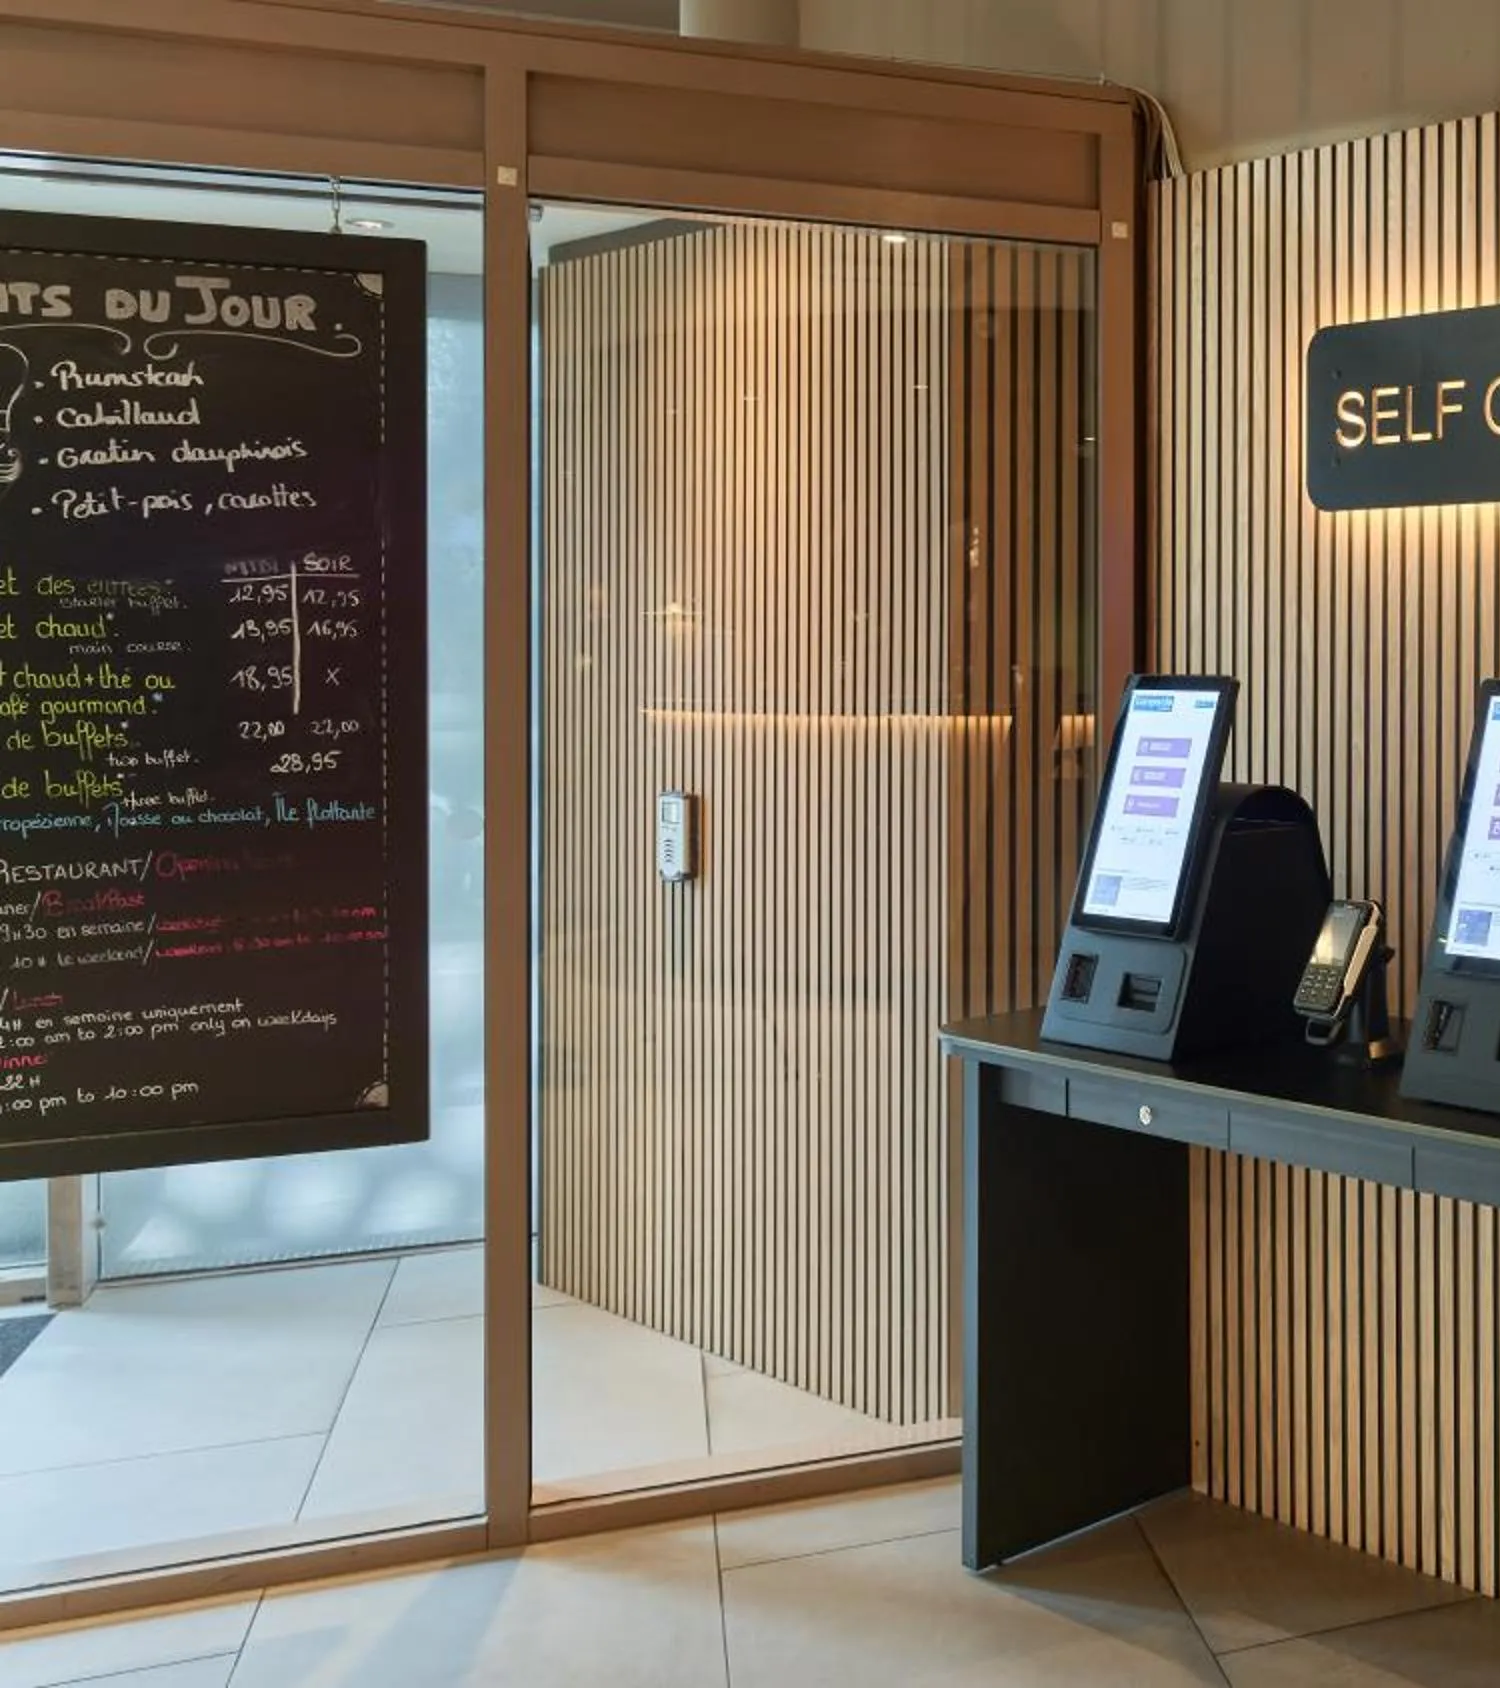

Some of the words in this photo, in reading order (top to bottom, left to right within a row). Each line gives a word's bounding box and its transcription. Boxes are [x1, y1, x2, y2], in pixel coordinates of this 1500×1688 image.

[1335, 381, 1466, 448] SELF
[57, 438, 156, 469] Gratin
[303, 552, 353, 572] SOIR
[269, 750, 342, 774] 28,95
